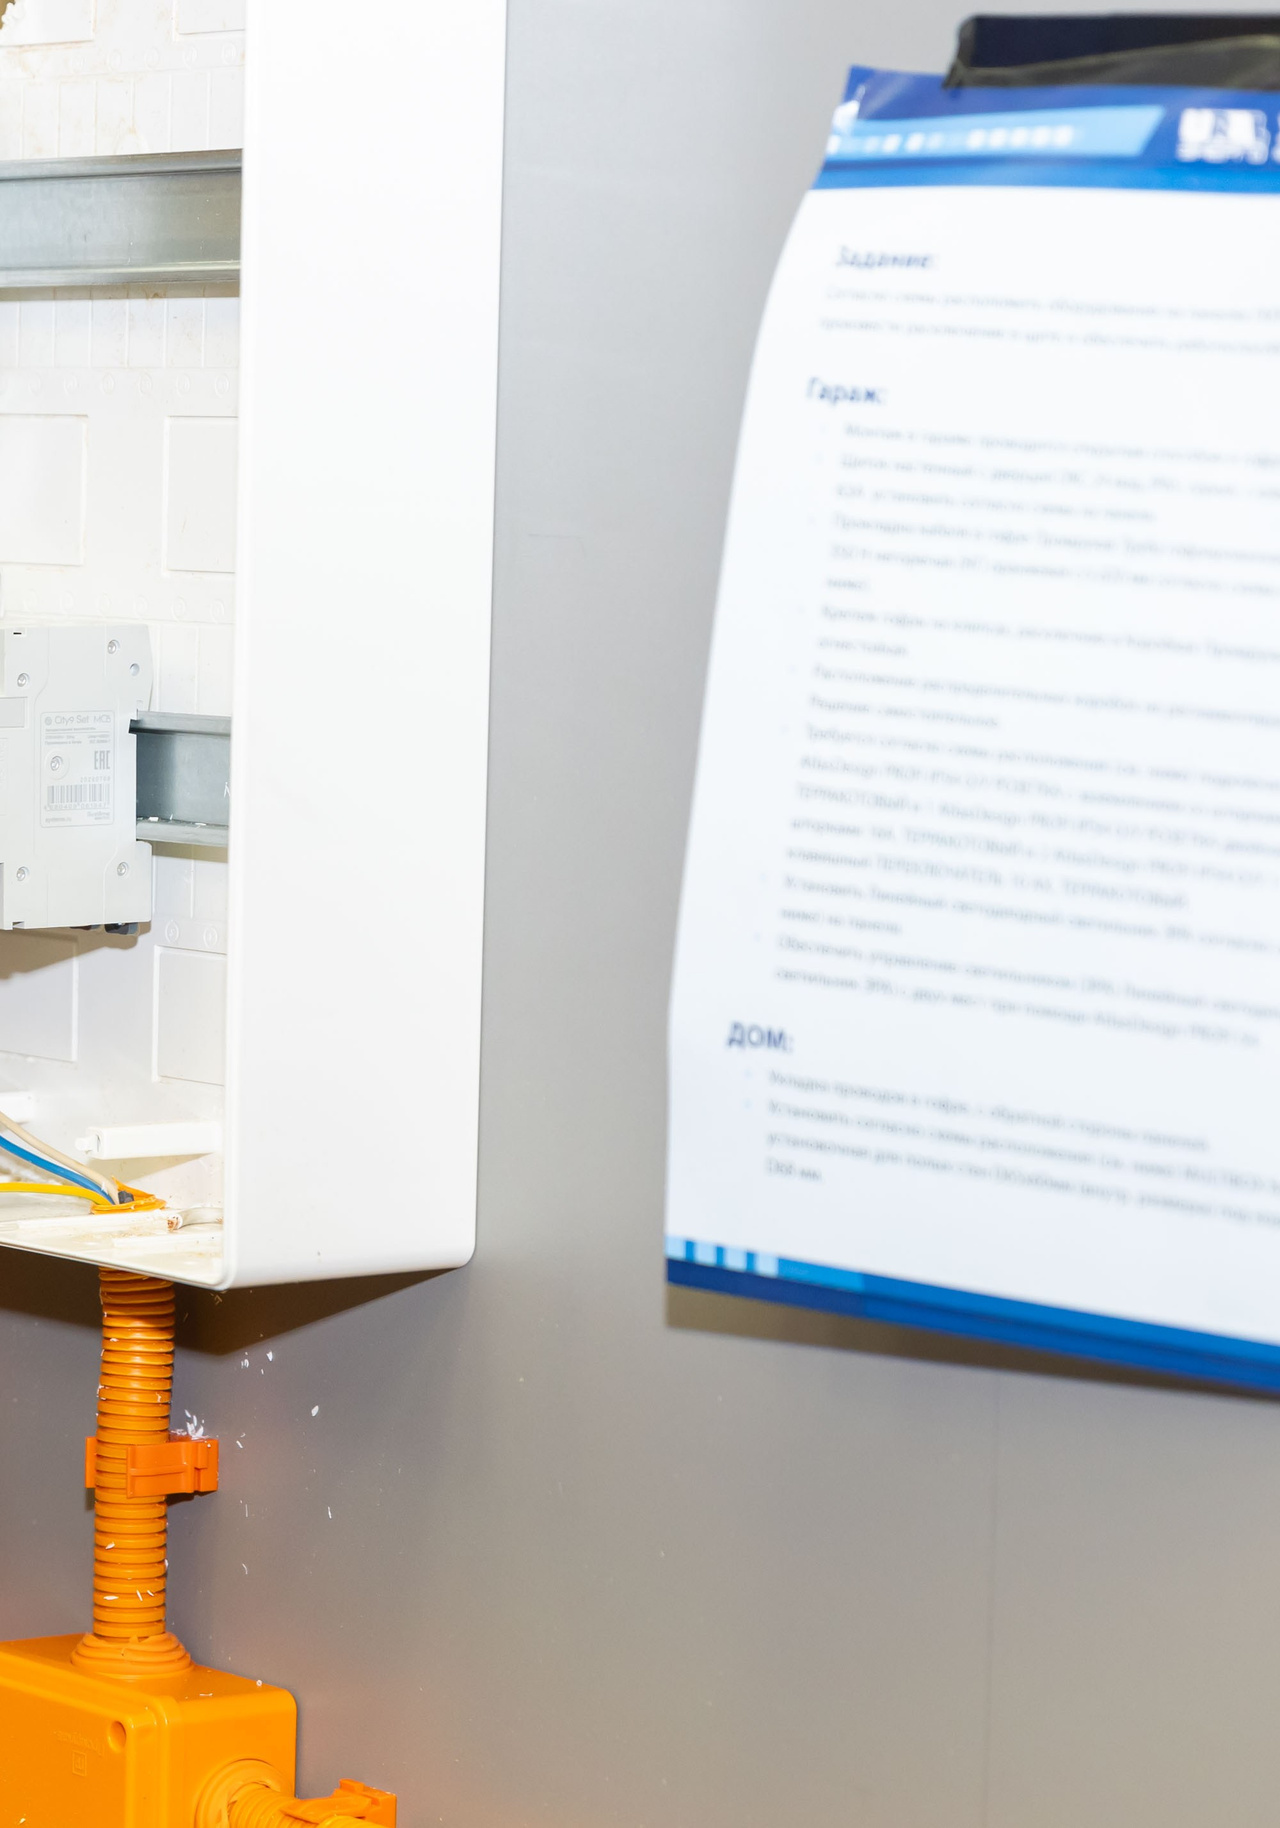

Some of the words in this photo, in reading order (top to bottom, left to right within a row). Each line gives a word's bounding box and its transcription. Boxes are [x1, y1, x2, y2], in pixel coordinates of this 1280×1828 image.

[54, 715, 74, 726] City9
[76, 714, 89, 723] Set
[93, 750, 110, 770] EAC
[726, 1020, 794, 1055] ДОМ:
